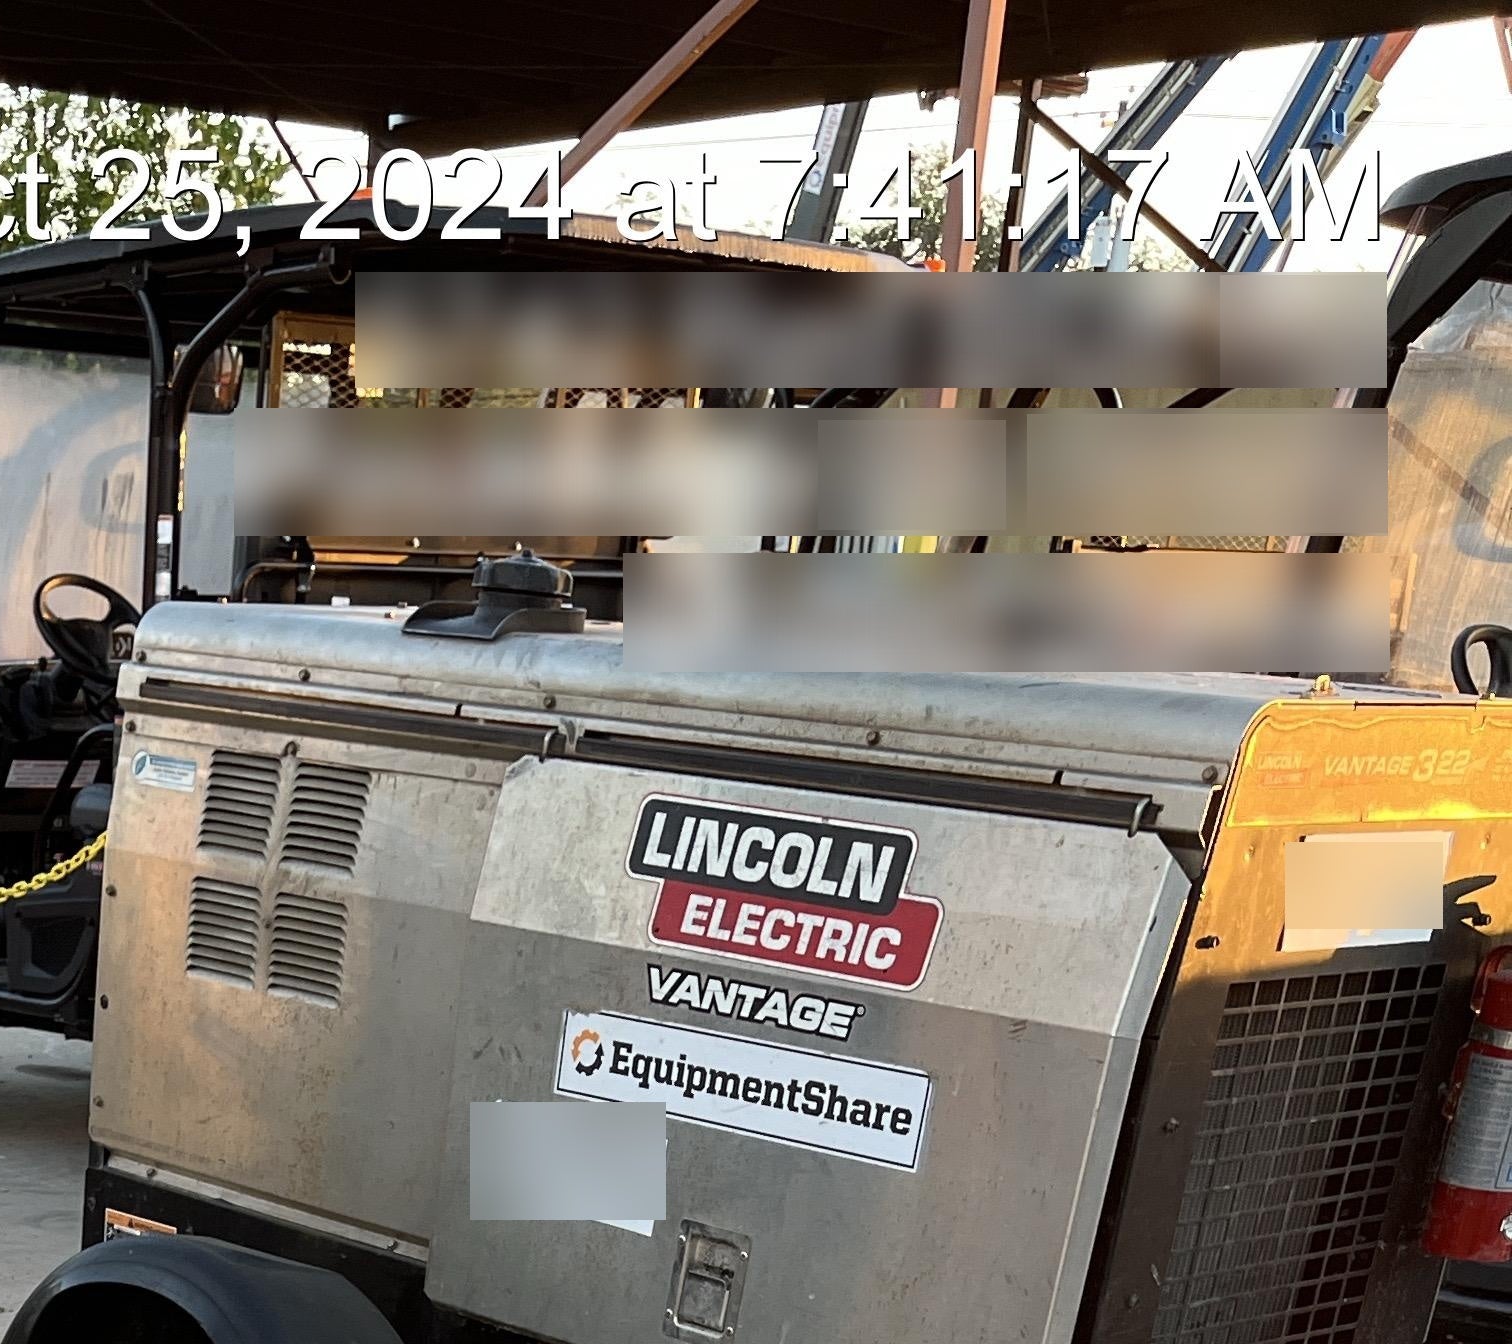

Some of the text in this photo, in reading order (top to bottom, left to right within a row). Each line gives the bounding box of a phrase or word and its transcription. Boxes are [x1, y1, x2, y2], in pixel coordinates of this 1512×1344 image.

[1323, 755, 1415, 777] VANTAGE
[1412, 748, 1472, 783] 322
[642, 811, 896, 904] LINCOLN
[680, 893, 903, 970] ELECTRIC
[648, 965, 856, 1040] VANTAGE
[609, 1040, 913, 1136] EquipmentShare
